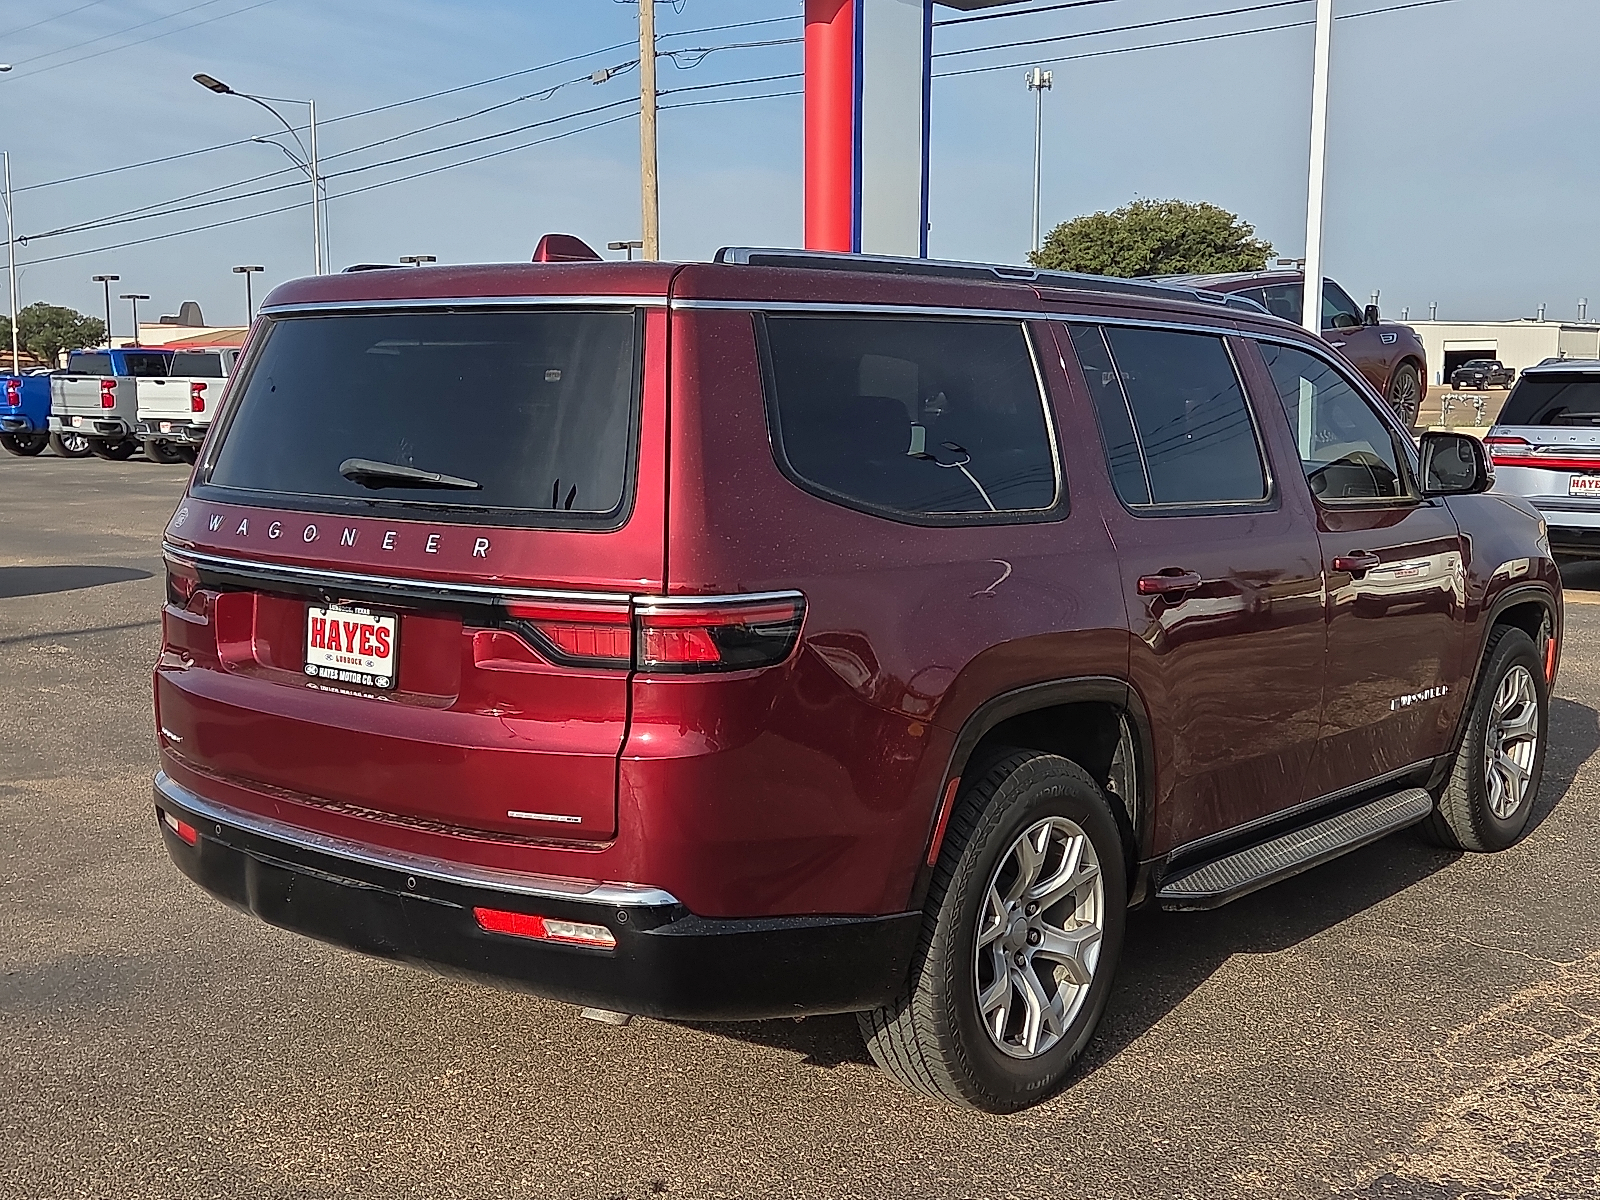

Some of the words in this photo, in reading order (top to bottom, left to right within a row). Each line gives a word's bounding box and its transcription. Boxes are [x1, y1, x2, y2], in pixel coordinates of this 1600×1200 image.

[208, 513, 490, 558] WAGONEER
[310, 616, 391, 659] HAYES
[318, 667, 339, 680] HAYES
[339, 670, 362, 684] MOTOR
